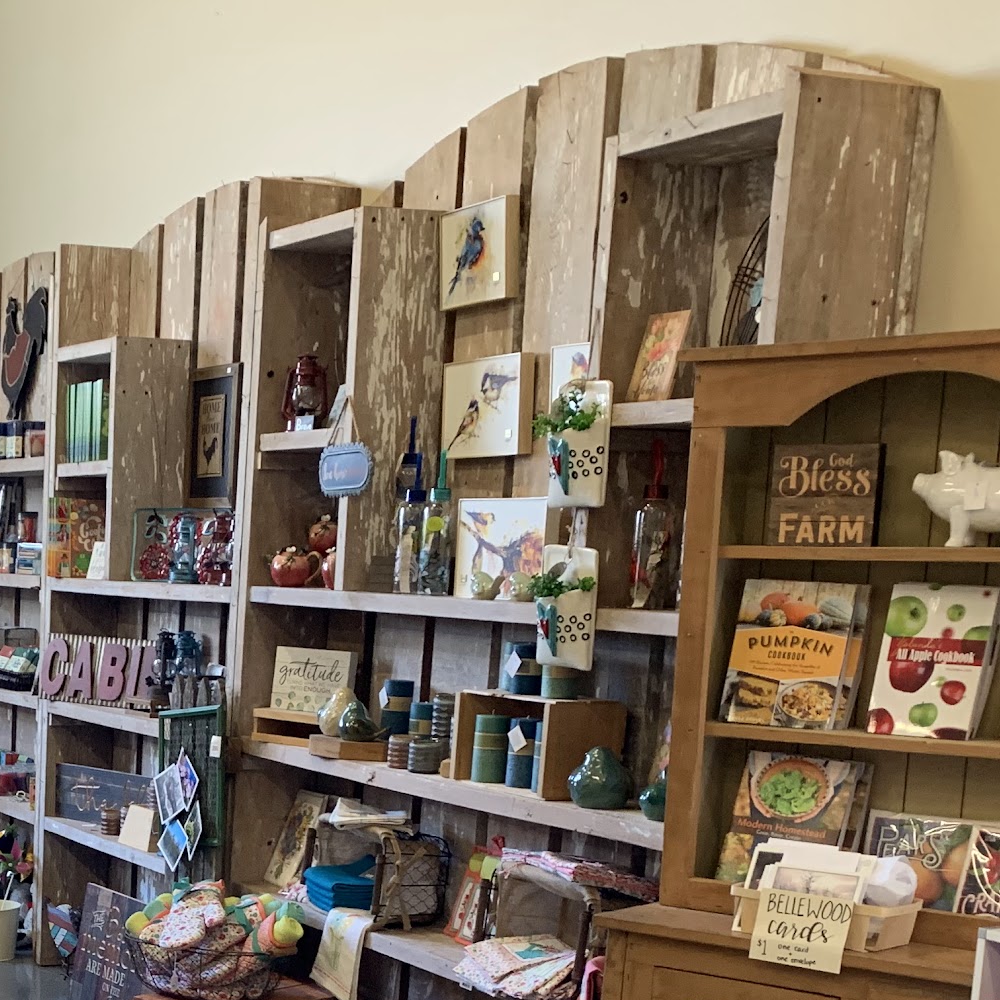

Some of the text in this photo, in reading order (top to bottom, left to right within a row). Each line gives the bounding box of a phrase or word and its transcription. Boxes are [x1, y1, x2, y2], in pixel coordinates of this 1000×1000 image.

[829, 452, 855, 468] God
[778, 455, 871, 499] Bless
[778, 512, 865, 544] FARM
[748, 635, 834, 657] PUMPKIN
[767, 650, 806, 661] COOKBOOK
[896, 648, 975, 665] All Apple Cookbook
[279, 658, 344, 685] gratitude
[303, 685, 331, 693] ENOUGH
[738, 818, 827, 838] Modern Homestead
[767, 893, 852, 924] BELLEWOOD
[768, 920, 835, 943] cards
[756, 939, 767, 956] $1
[86, 957, 126, 988] ARE MADE
[791, 957, 816, 967] envelope
